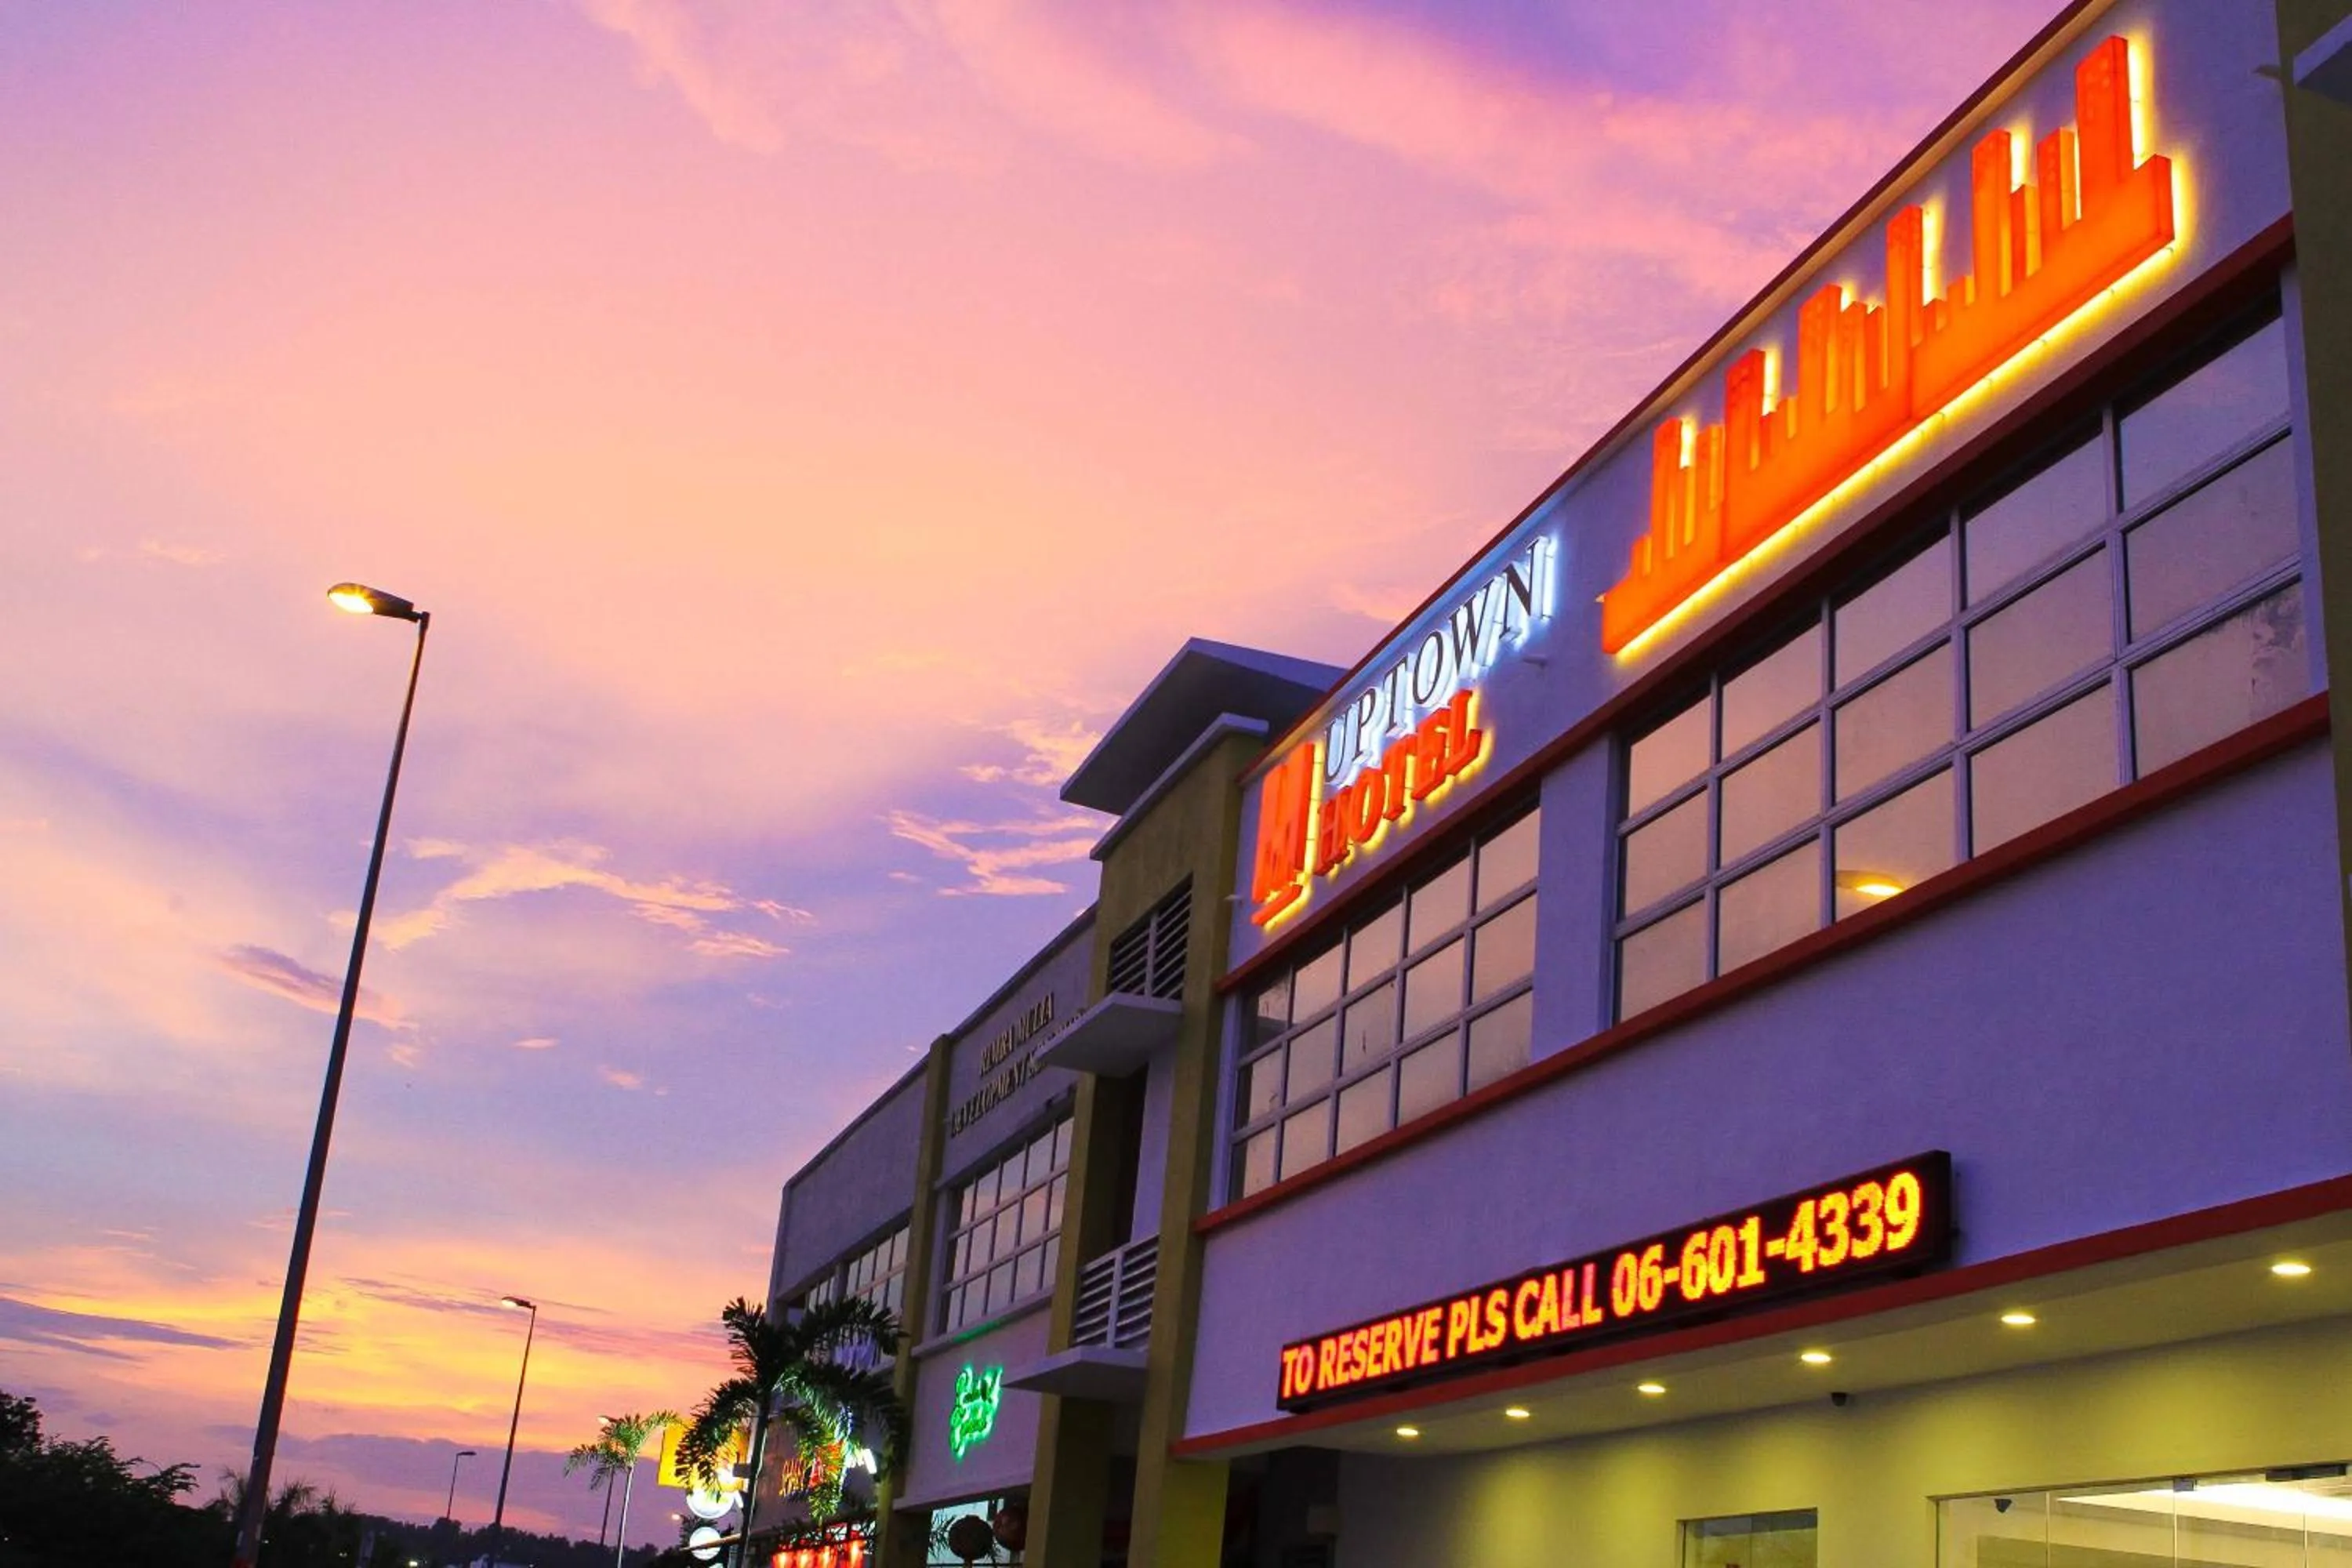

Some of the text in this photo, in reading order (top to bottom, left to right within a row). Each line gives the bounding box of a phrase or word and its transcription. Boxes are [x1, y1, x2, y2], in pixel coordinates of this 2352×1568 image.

[1324, 535, 1557, 782] UPTOWN
[1316, 688, 1483, 877] HOTEL
[1282, 1171, 1921, 1398] TO RESERVE PLS CALL 06-601-4339
